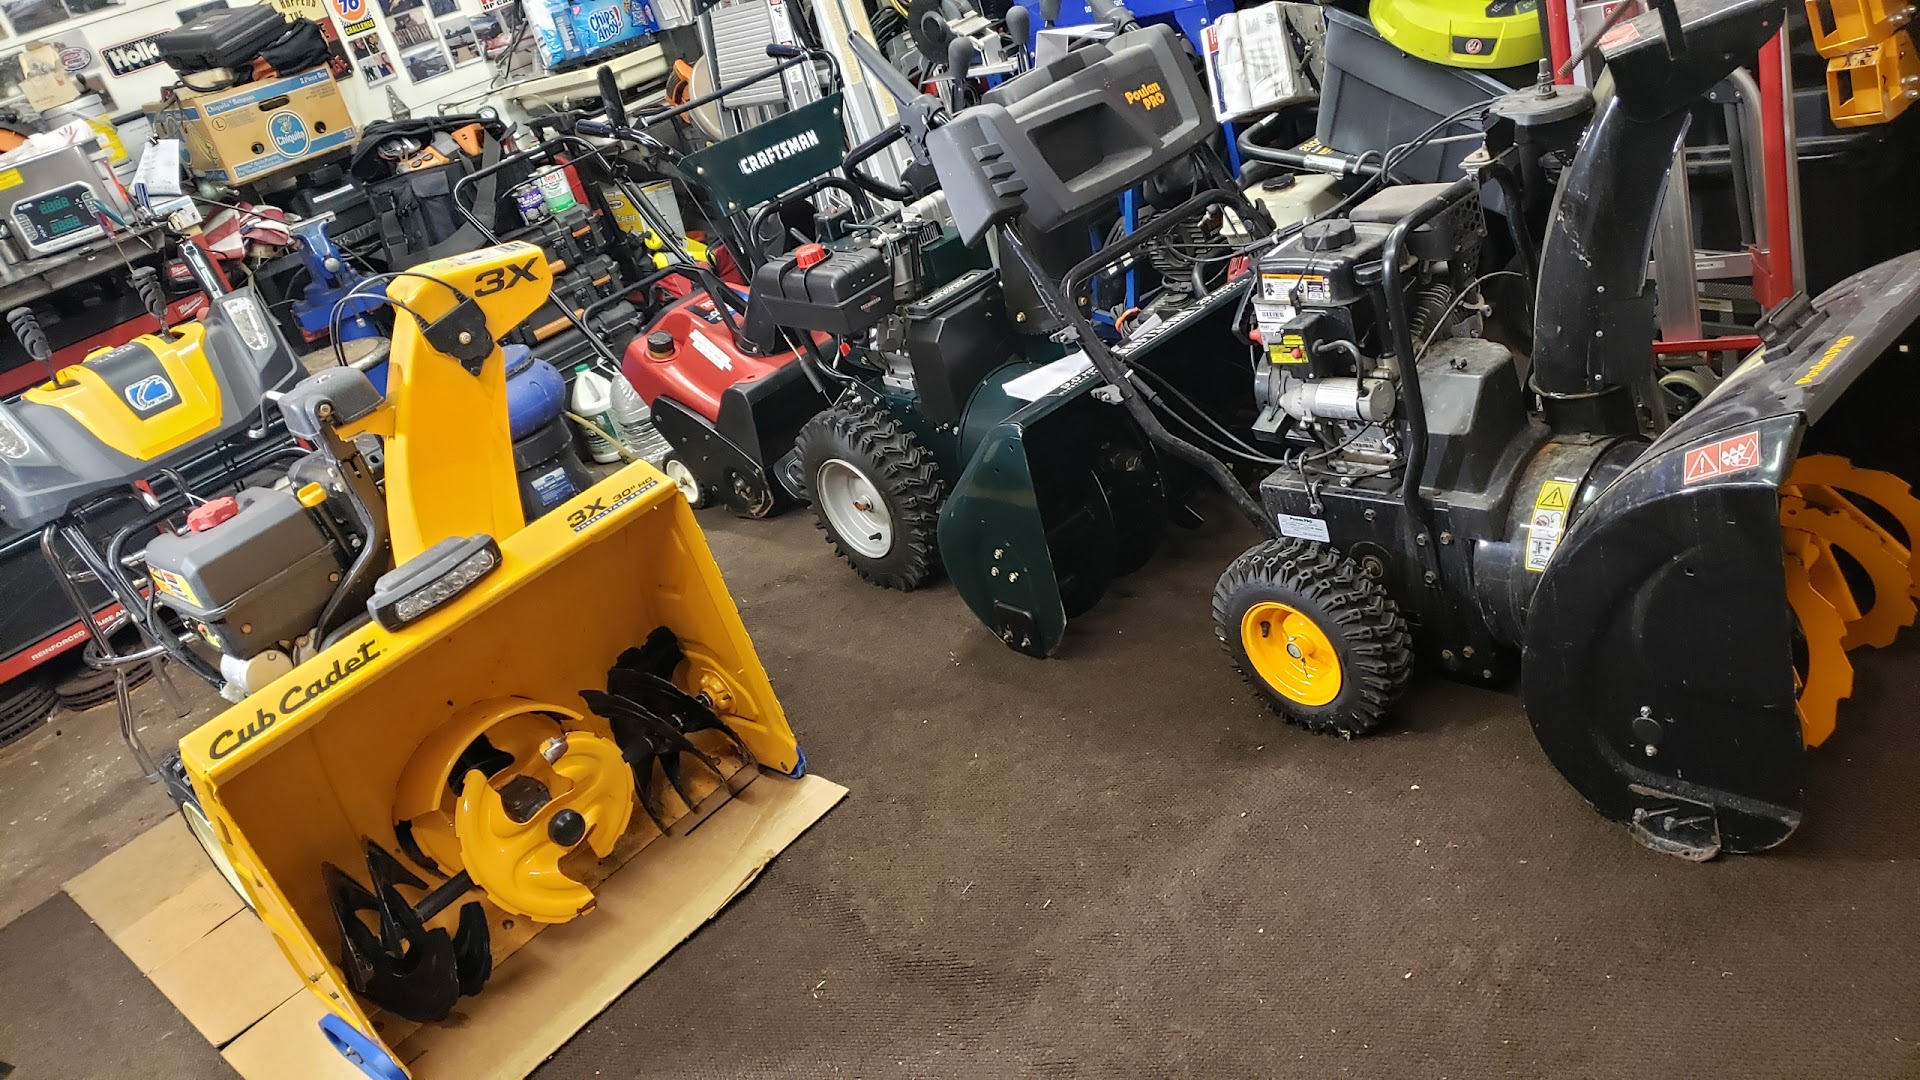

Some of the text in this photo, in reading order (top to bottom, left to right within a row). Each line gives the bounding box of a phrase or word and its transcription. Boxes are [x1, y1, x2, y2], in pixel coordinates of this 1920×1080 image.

[338, 0, 361, 13] 76
[345, 20, 375, 36] CHALLENGE
[590, 9, 617, 31] Chips
[1125, 82, 1160, 104] Poulan
[1143, 92, 1165, 110] PRO
[216, 120, 224, 129] L
[276, 129, 306, 147] Chiquita
[738, 129, 820, 174] CRAFTSMAN
[475, 256, 540, 298] 3X
[1116, 306, 1200, 354] RAFTSMAN
[567, 497, 607, 529] 3X
[31, 630, 86, 661] REINFORCED
[209, 640, 380, 760] Cub Cadet
